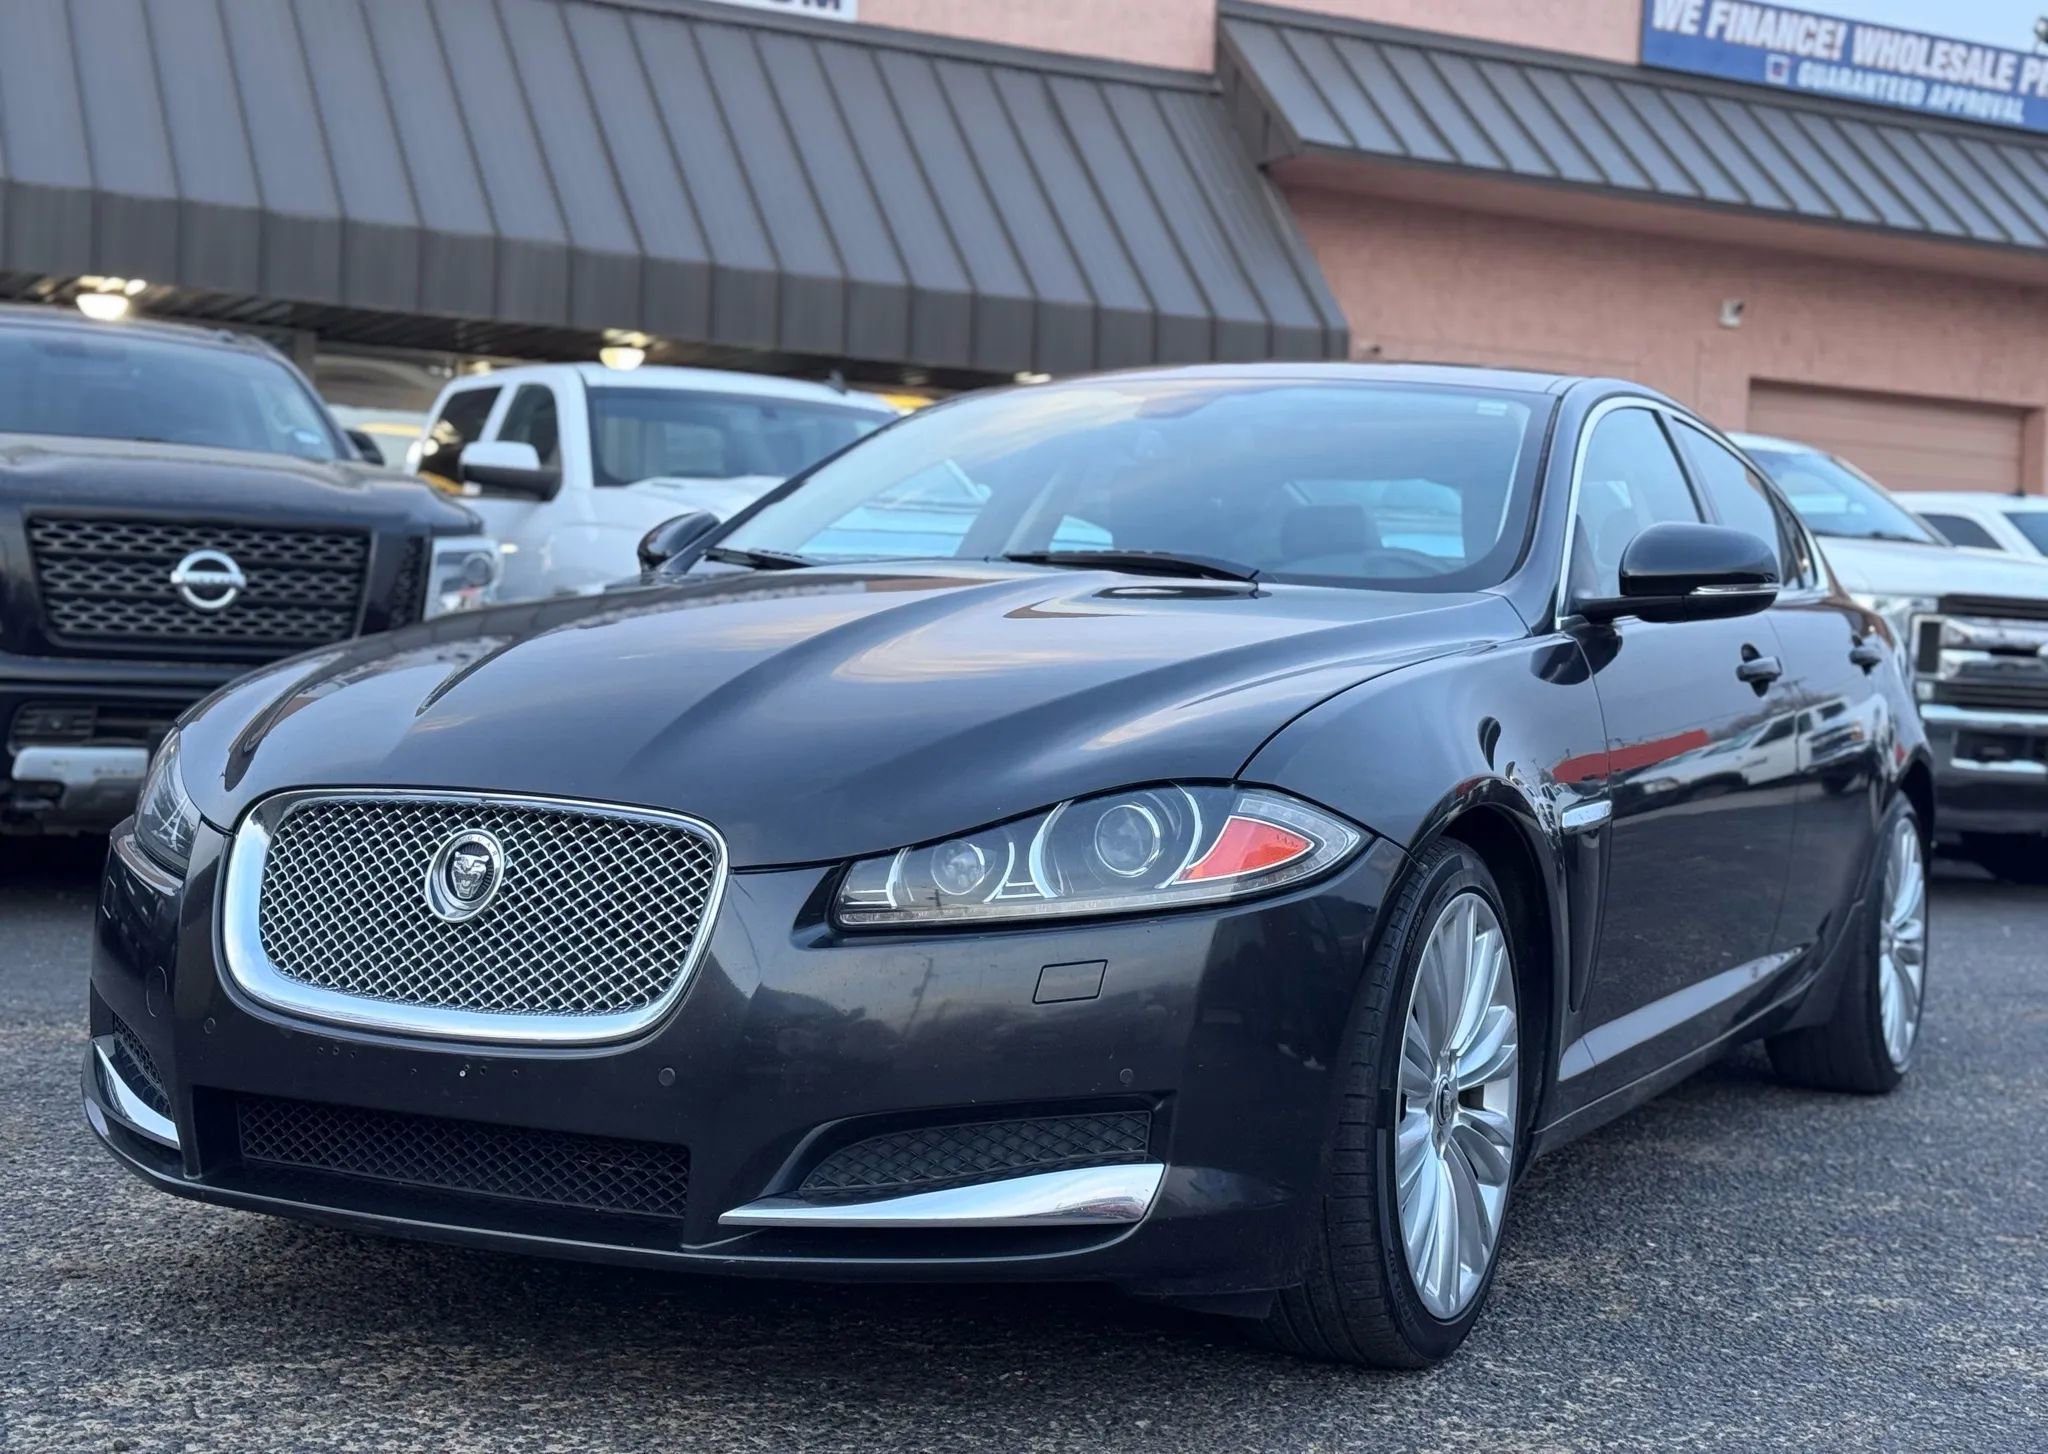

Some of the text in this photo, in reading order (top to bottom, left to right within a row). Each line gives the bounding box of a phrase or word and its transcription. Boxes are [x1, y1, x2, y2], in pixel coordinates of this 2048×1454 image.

[1652, 0, 1702, 36] WE
[1705, 1, 1849, 61] FINANCE!
[1852, 25, 2019, 92] WHOLESALE
[1797, 61, 2025, 123] GUARANTEED APPROVAL
